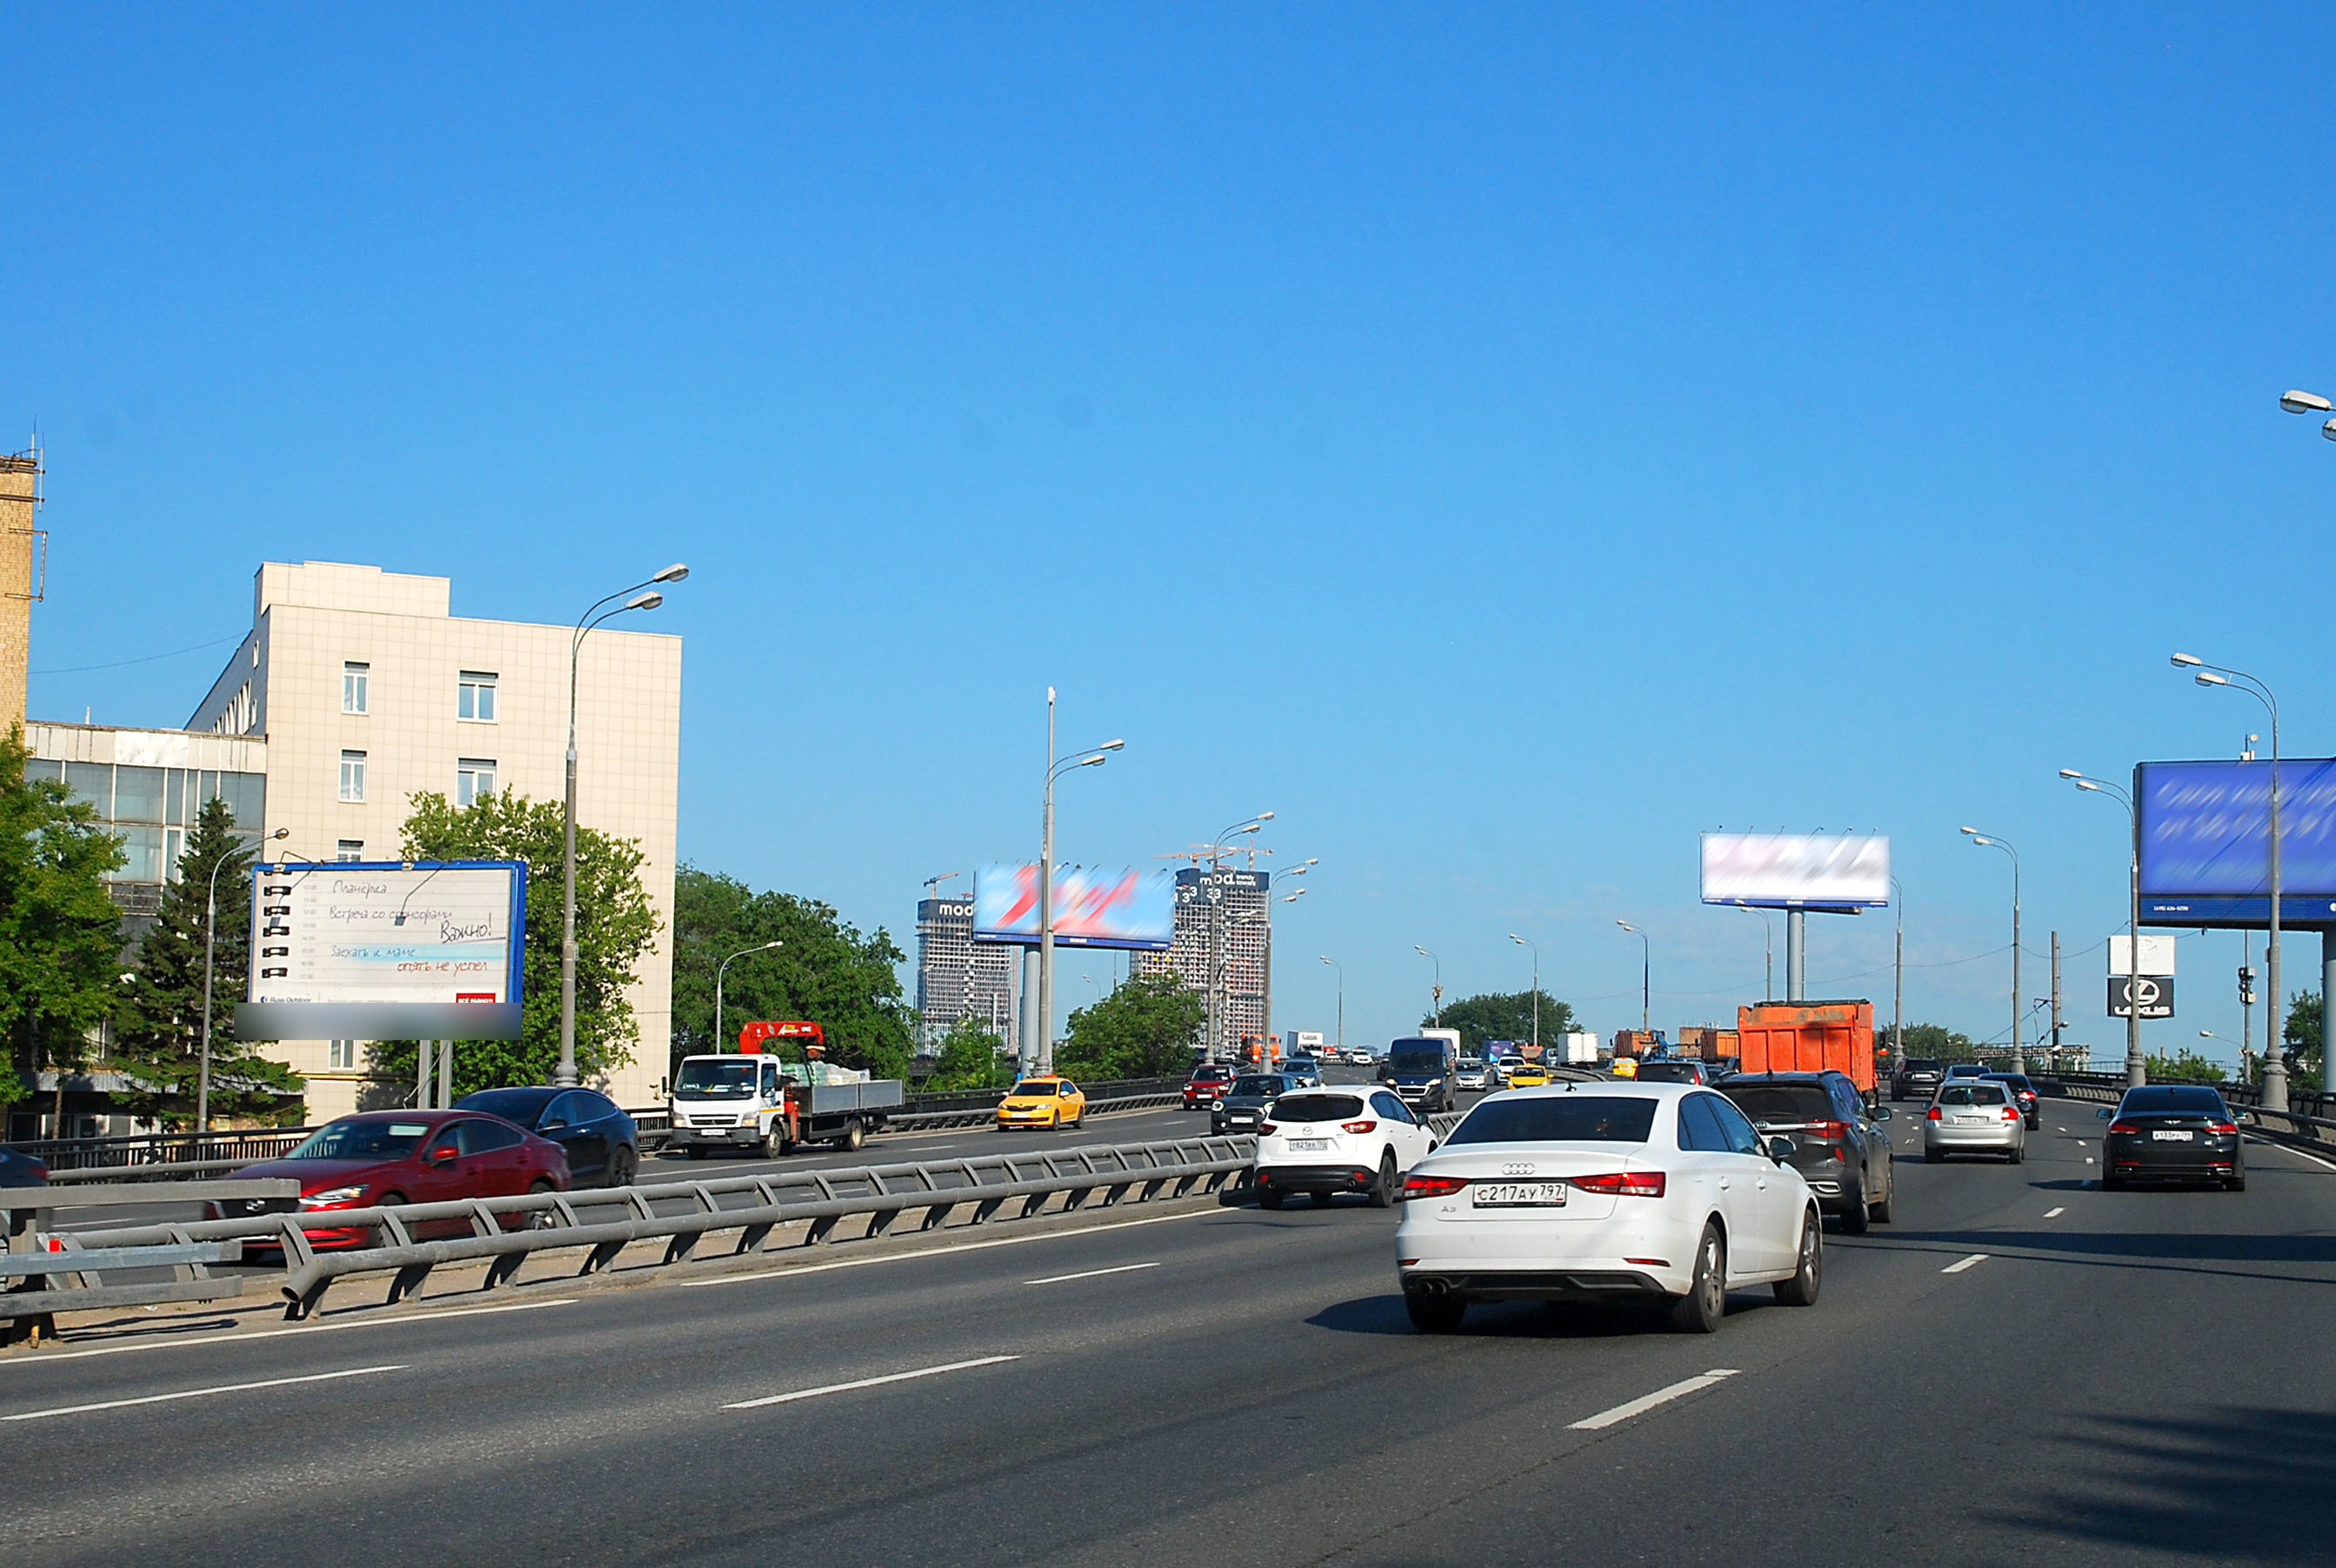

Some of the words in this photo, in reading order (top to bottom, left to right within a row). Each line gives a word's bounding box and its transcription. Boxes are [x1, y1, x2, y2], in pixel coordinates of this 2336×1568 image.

[330, 905, 369, 924] Встреча
[371, 911, 385, 919] со
[440, 911, 492, 944] Важно!
[330, 944, 369, 957] Заехать
[385, 948, 416, 957] маме
[397, 962, 431, 972] опять
[436, 962, 450, 971] не
[453, 962, 488, 977] успел
[1539, 1184, 1562, 1197] 797
